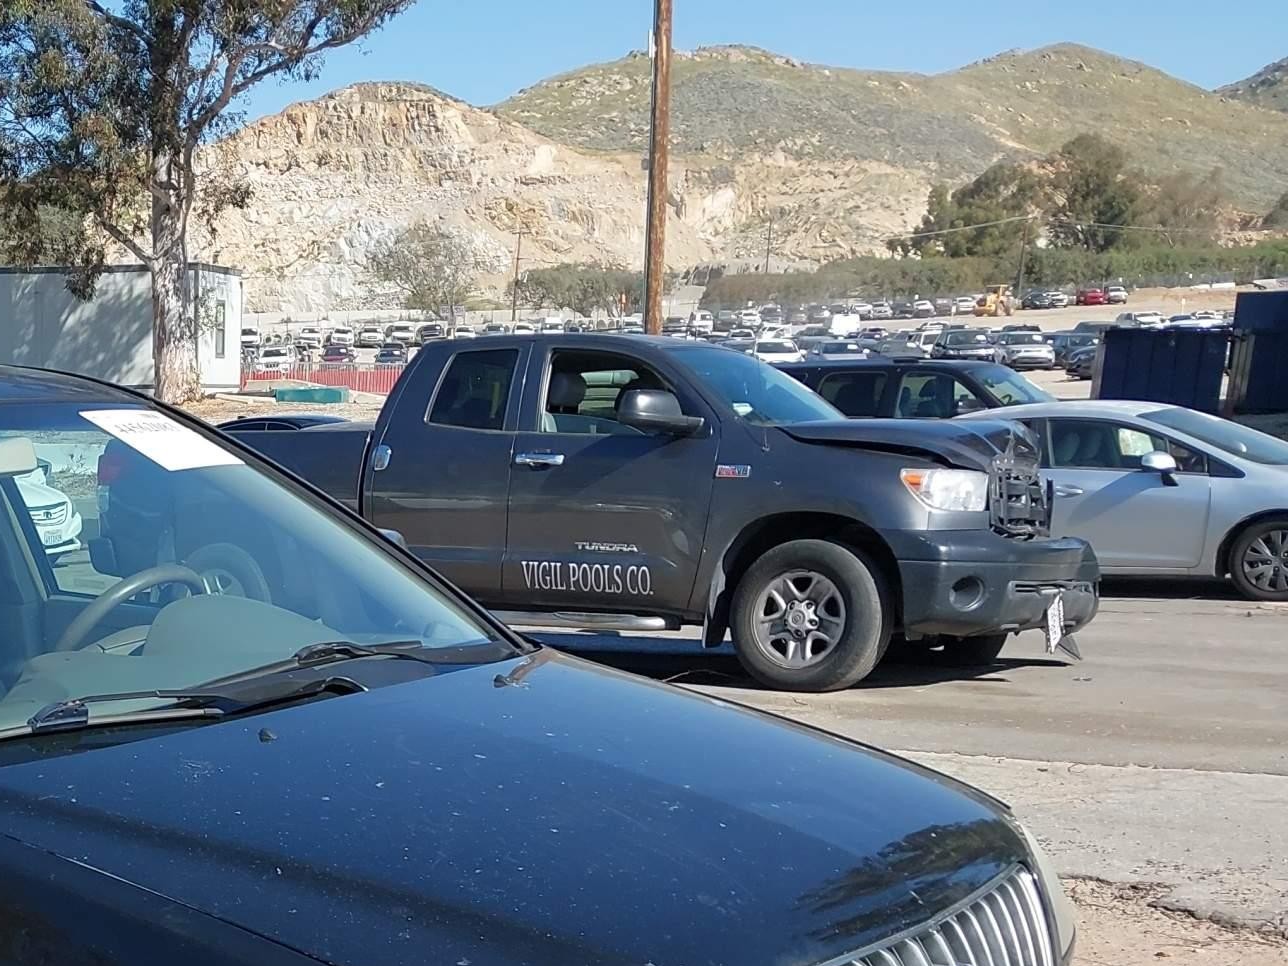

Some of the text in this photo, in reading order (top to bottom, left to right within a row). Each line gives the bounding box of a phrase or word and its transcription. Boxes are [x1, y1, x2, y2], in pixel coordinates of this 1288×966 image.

[573, 541, 639, 553] TUNDRA
[520, 560, 654, 596] VIGIL POOLS CO.
